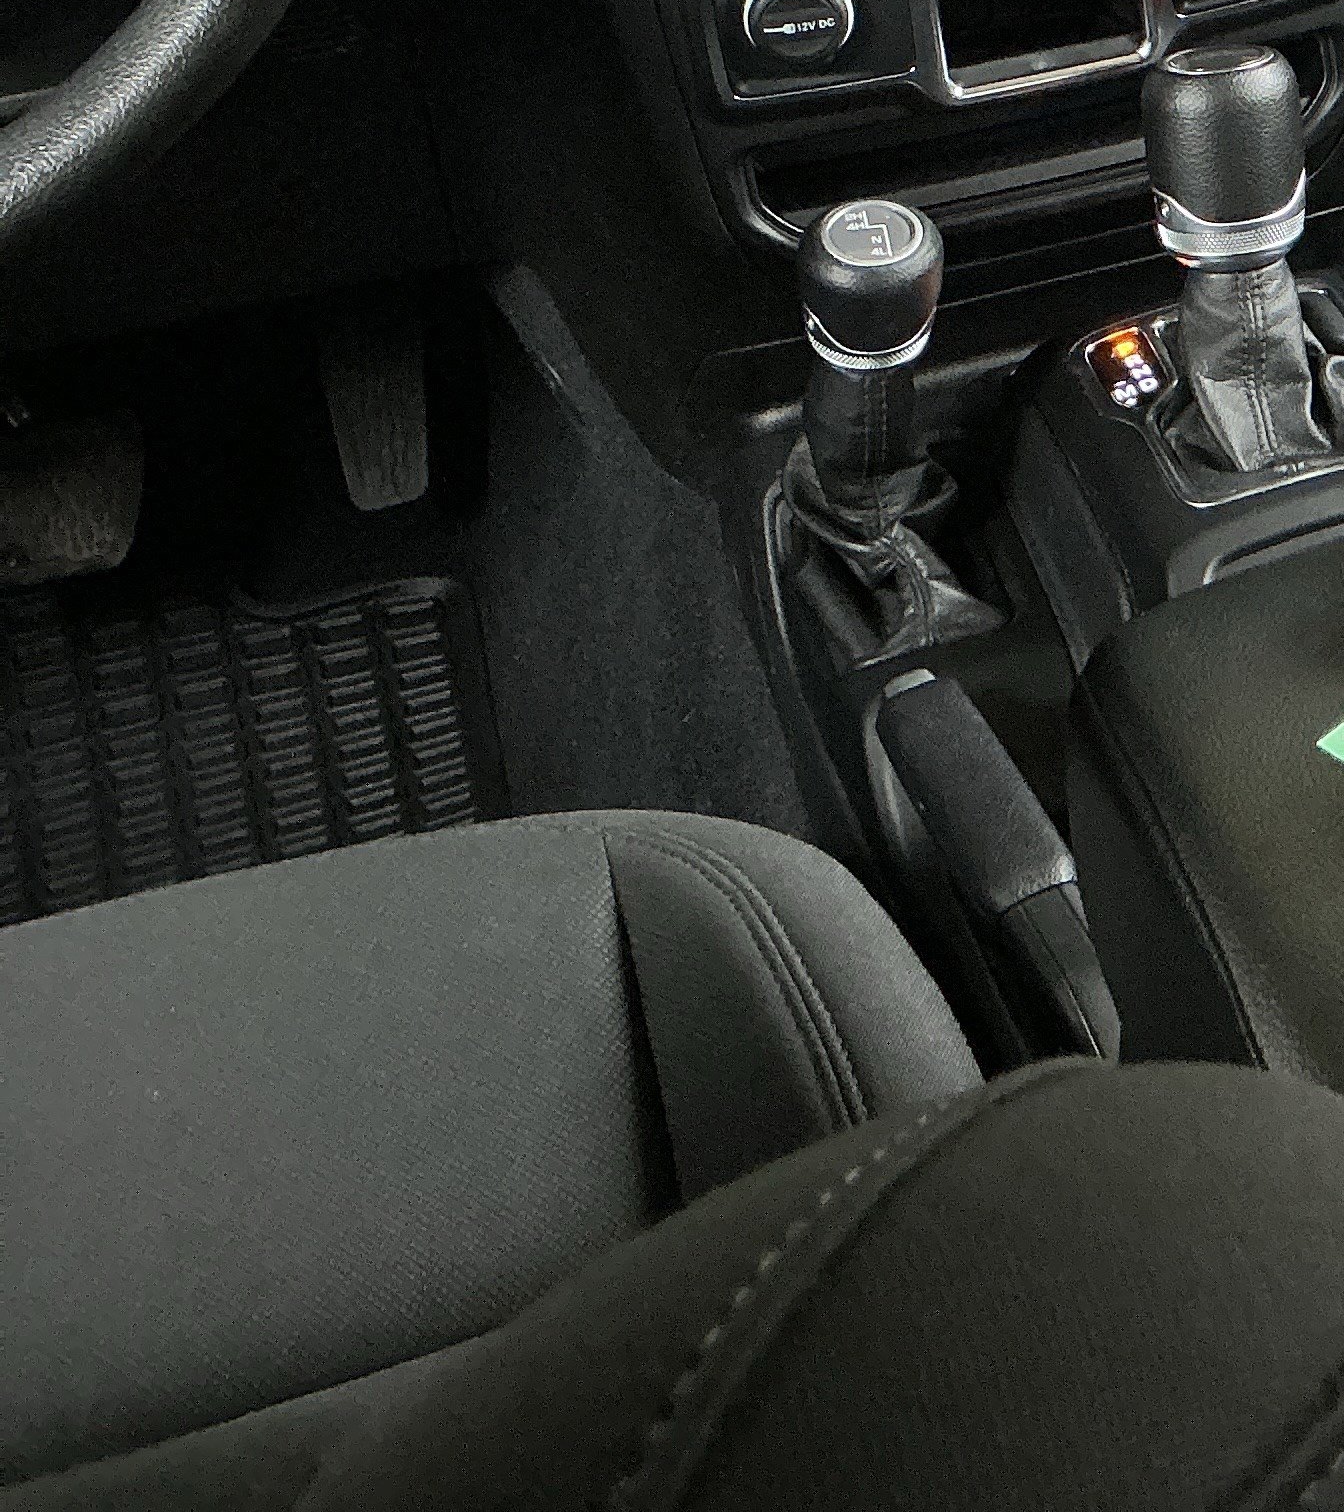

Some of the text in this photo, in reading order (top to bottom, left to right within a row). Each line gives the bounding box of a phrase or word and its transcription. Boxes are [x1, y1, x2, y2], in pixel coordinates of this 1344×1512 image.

[797, 18, 836, 32] 12V DC
[846, 222, 867, 231] 4H
[870, 235, 882, 244] N
[870, 248, 887, 256] 4L
